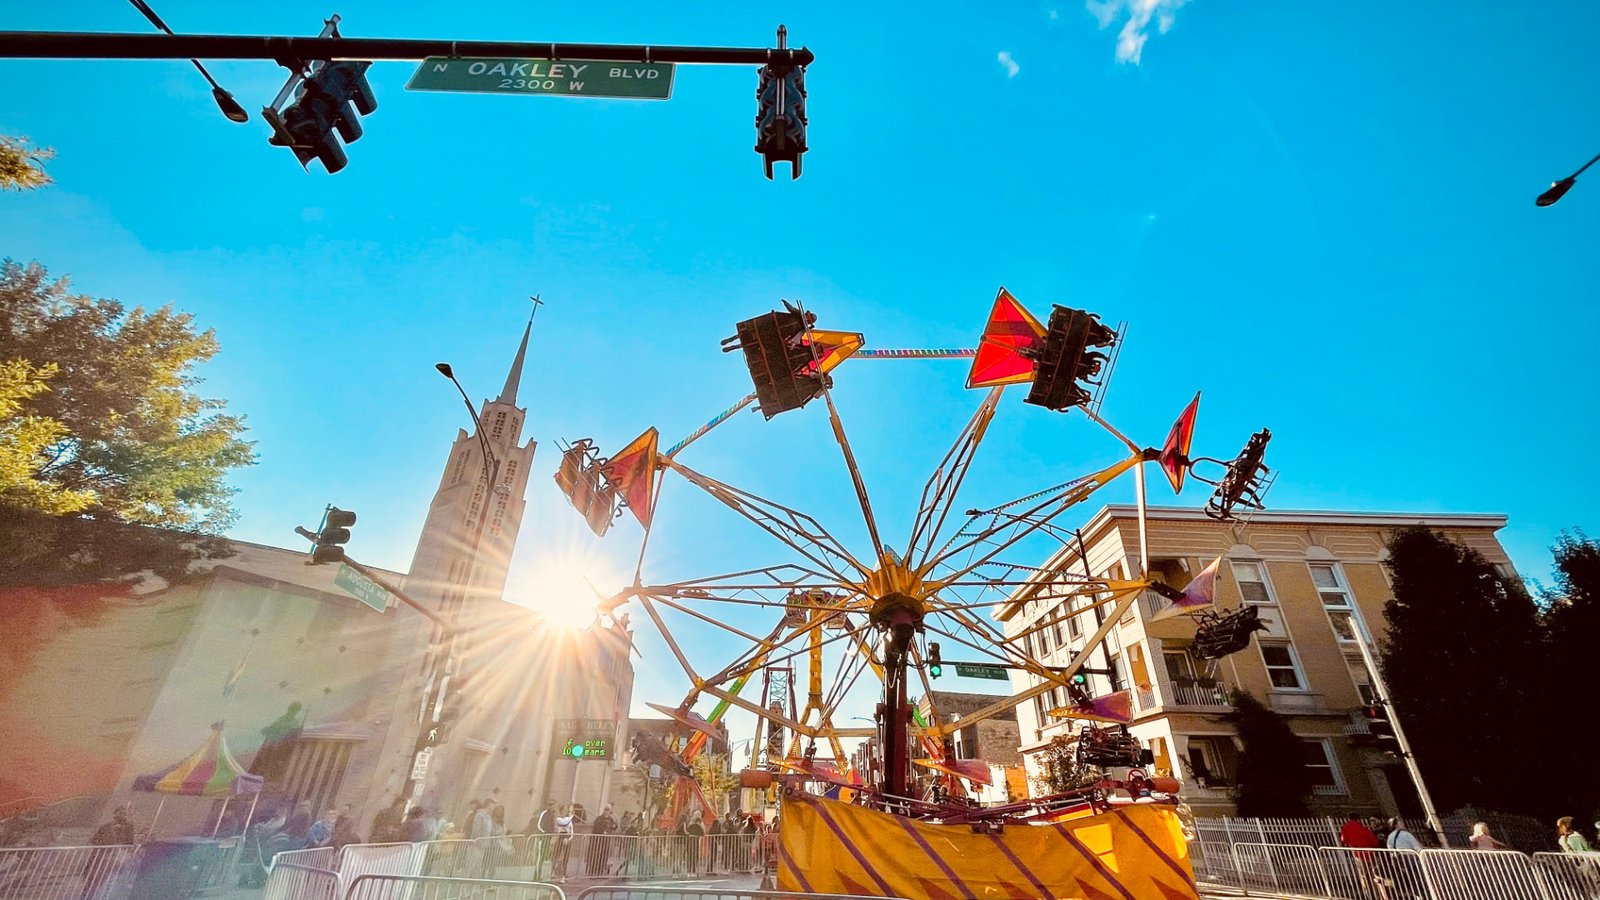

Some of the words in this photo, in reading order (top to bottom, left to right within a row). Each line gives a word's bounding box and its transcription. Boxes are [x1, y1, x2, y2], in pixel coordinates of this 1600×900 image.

[433, 63, 448, 73] N
[468, 62, 588, 78] OAKLEY
[608, 68, 659, 80] BLVD
[498, 78, 555, 90] 2300
[569, 80, 585, 91] W
